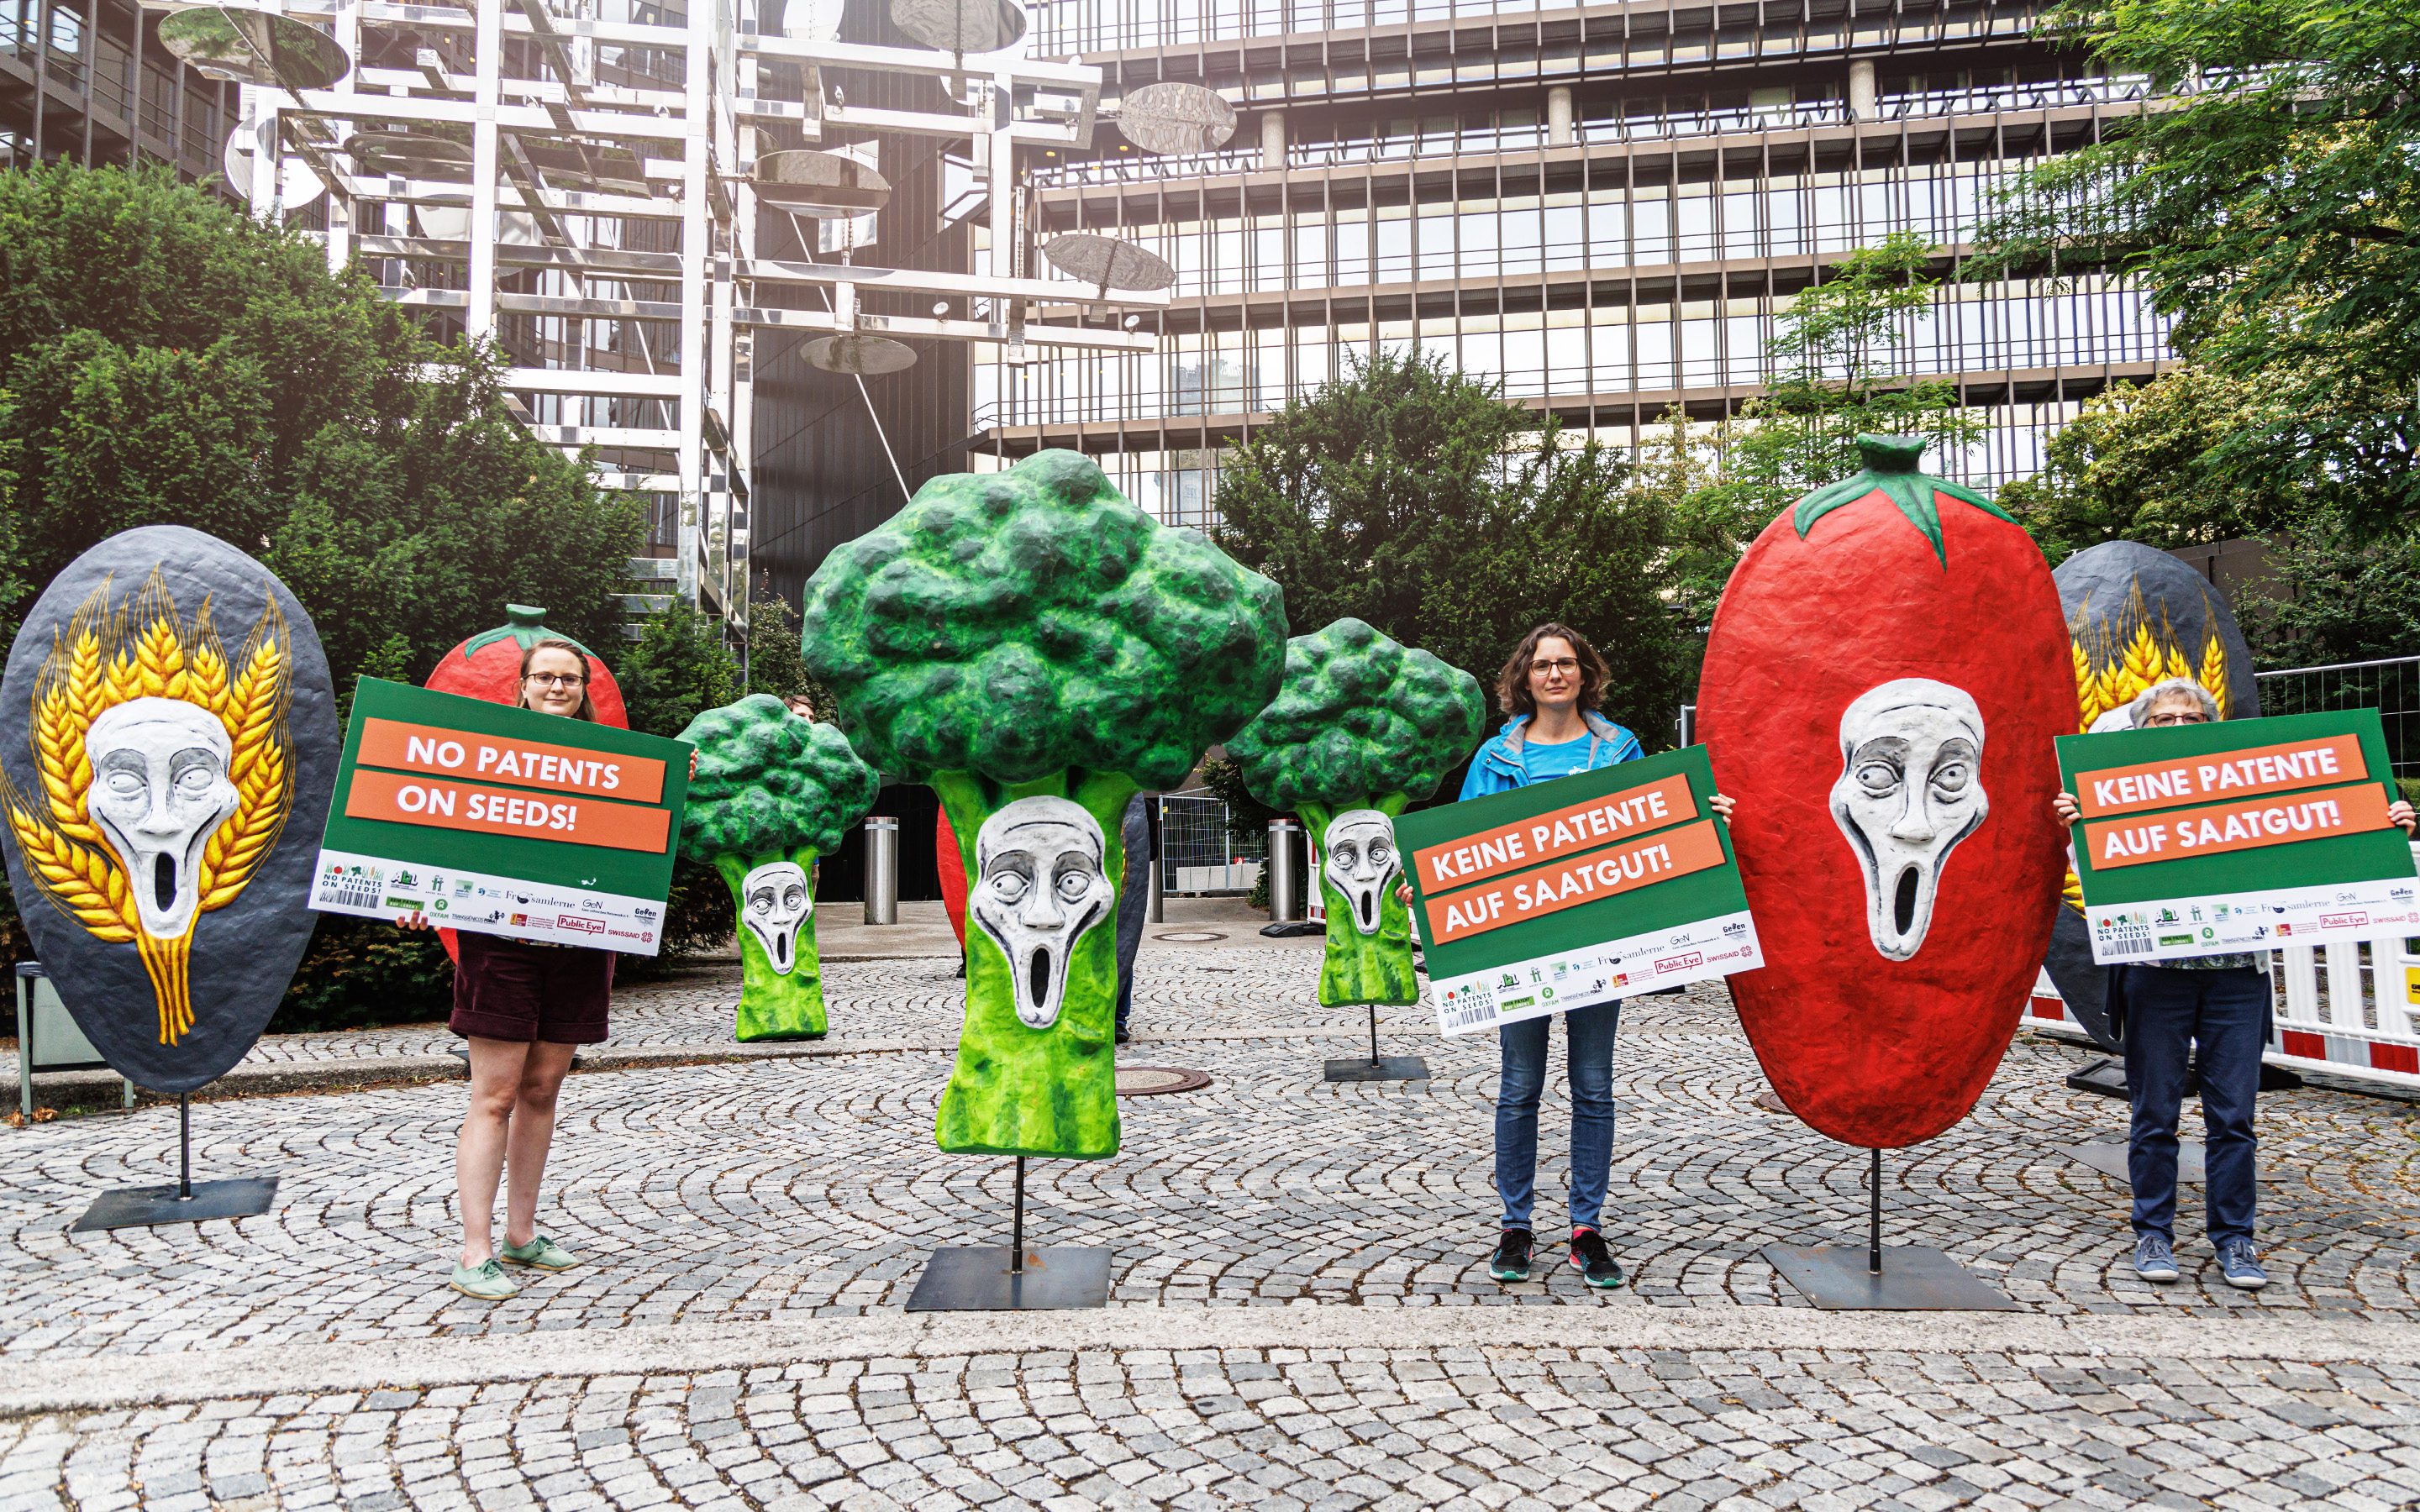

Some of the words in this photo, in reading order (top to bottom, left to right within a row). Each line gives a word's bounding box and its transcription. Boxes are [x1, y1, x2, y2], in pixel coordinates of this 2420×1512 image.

[406, 736, 465, 769] NO
[477, 746, 620, 790] PATENTS
[2093, 769, 2191, 807] KEINE
[2197, 748, 2339, 792] PATENTE
[397, 785, 456, 816] ON
[466, 794, 578, 832] SEEDS!
[2104, 825, 2168, 858] AUF
[2176, 800, 2342, 848] SAATGUT!
[1432, 833, 1526, 881] KEINE
[1532, 791, 1669, 852] PATENTE
[341, 876, 382, 888] PATENTS
[1445, 891, 1505, 932] AUF
[1513, 843, 1672, 911] SAATGUT!
[345, 884, 381, 894] SEEDS!
[429, 911, 450, 920] OXFAM
[2323, 916, 2348, 926] Public
[2349, 916, 2365, 925] Eye
[2372, 916, 2407, 924] SWISSAID
[560, 917, 585, 928] Public
[587, 921, 602, 932] Eye
[2112, 925, 2149, 933] PATENTS
[608, 929, 640, 939] SWISSAID
[2118, 931, 2151, 940] SEEDS!
[1658, 960, 1682, 970] Public
[1683, 956, 1699, 967] Eye
[1707, 951, 1739, 963] SWISSAID
[1457, 992, 1491, 1005] PATENTS
[1462, 998, 1493, 1011] SEEDS!
[1541, 999, 1560, 1008] OXFAM
